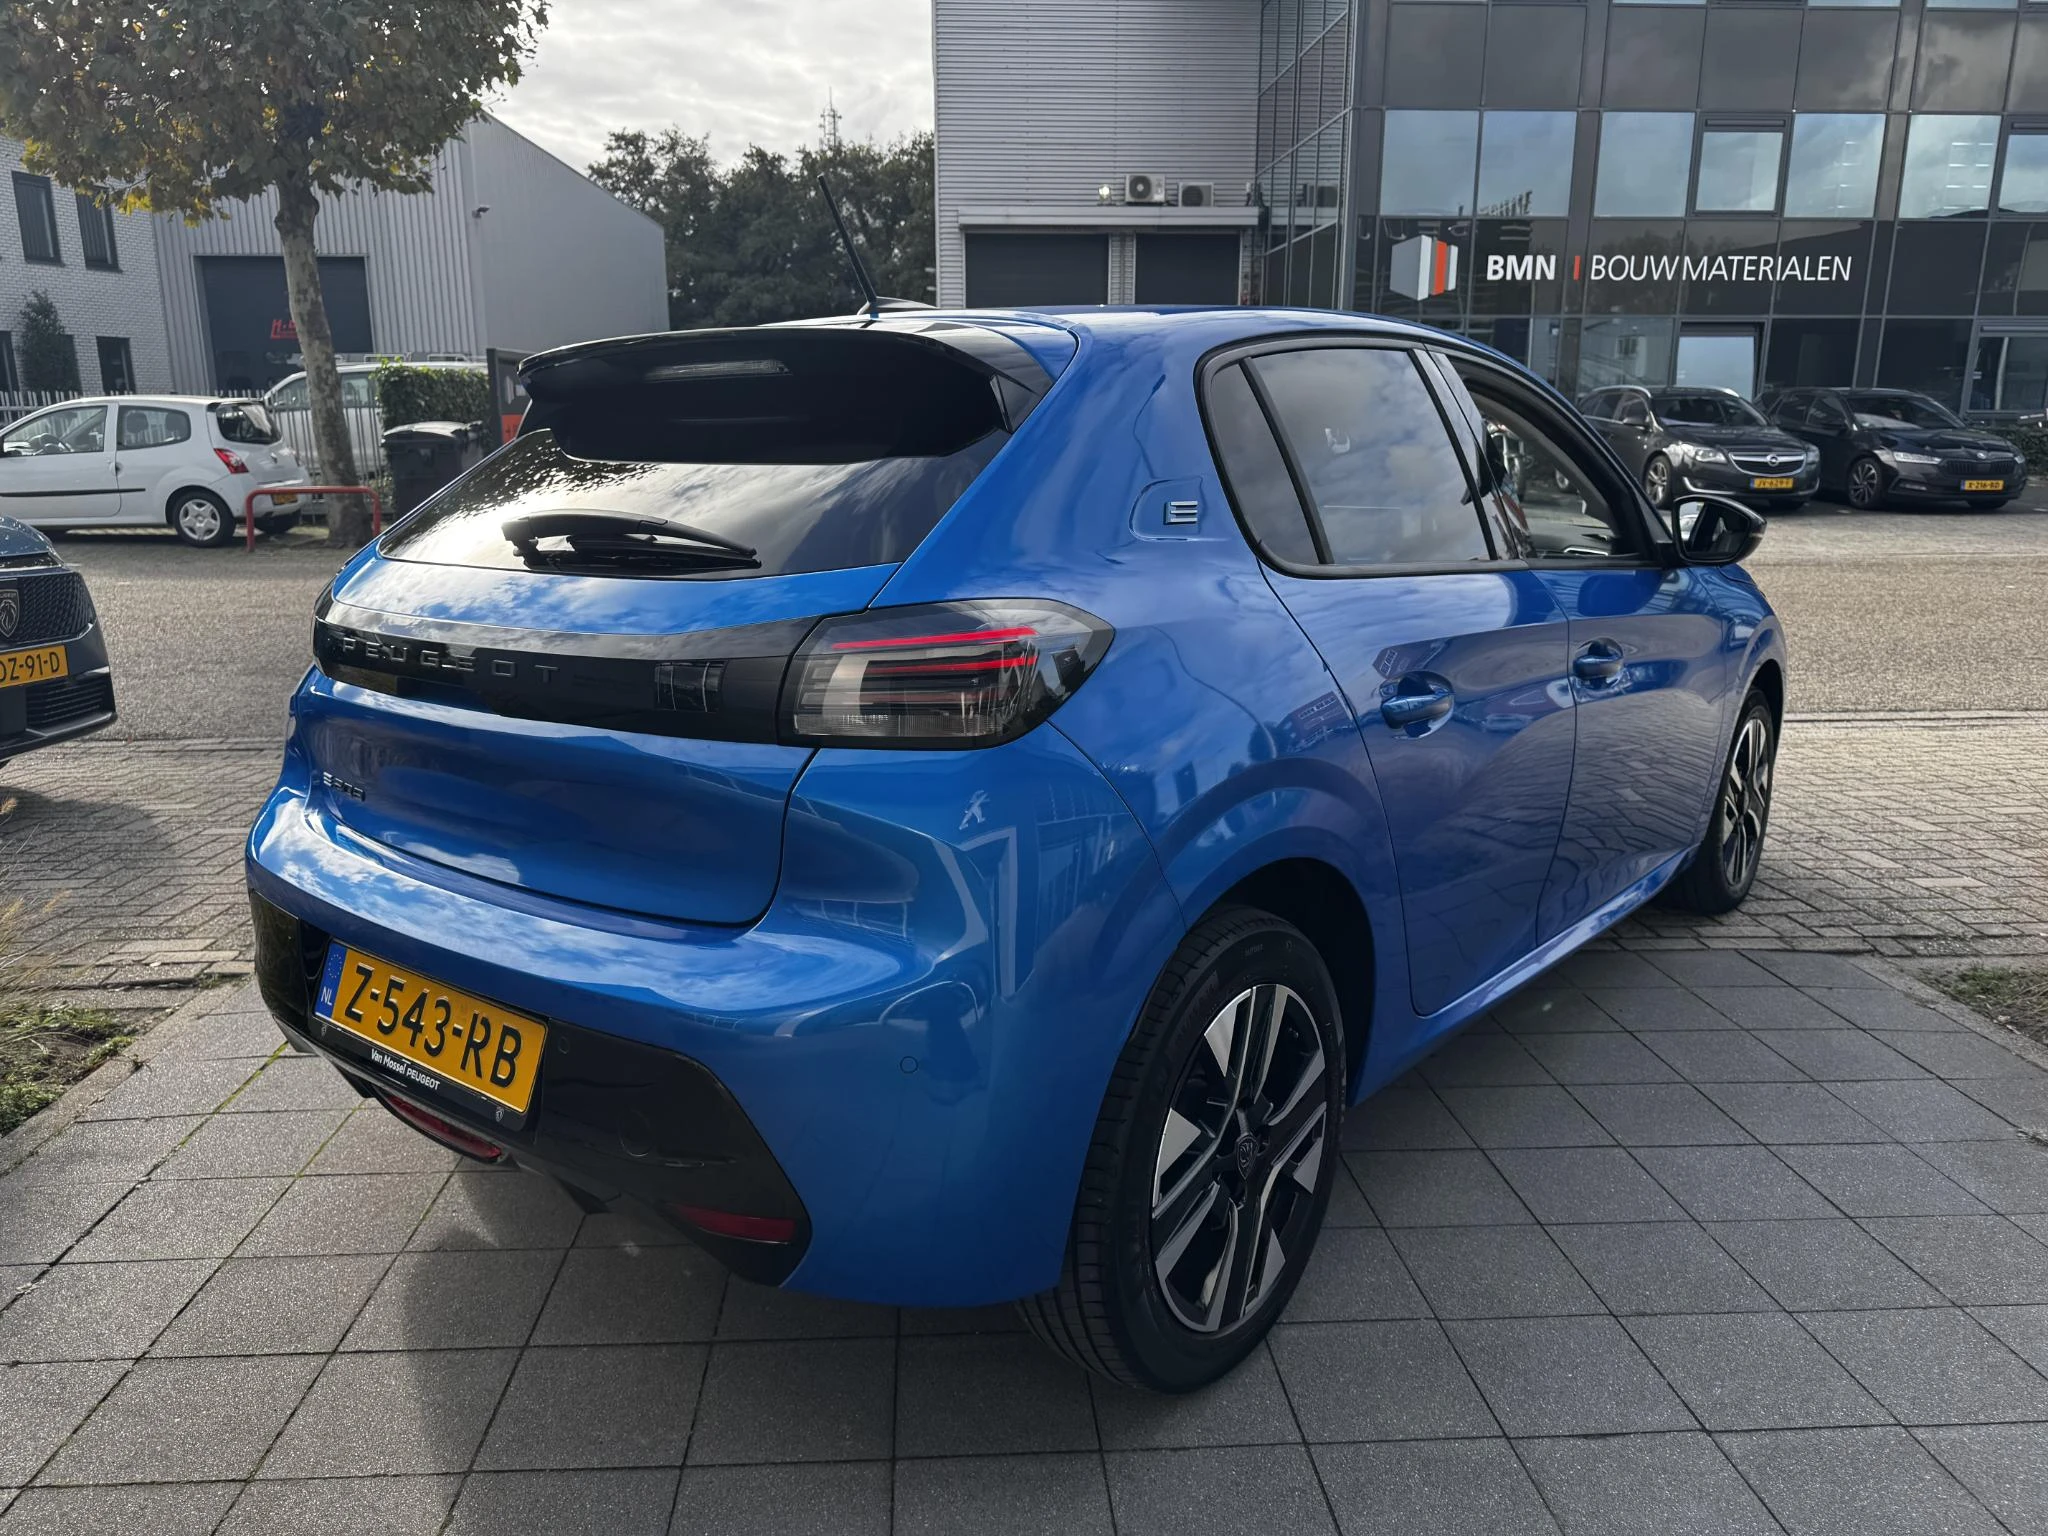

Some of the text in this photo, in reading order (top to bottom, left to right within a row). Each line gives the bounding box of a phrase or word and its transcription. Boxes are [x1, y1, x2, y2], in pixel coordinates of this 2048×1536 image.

[1486, 254, 1852, 281] BMN BOUWMATERIALEN
[342, 636, 558, 682] PEUGEOT
[320, 986, 333, 1006] NL
[344, 962, 522, 1088] Z-543-RB
[371, 1048, 440, 1090] Van Mossel PEUGEOT
